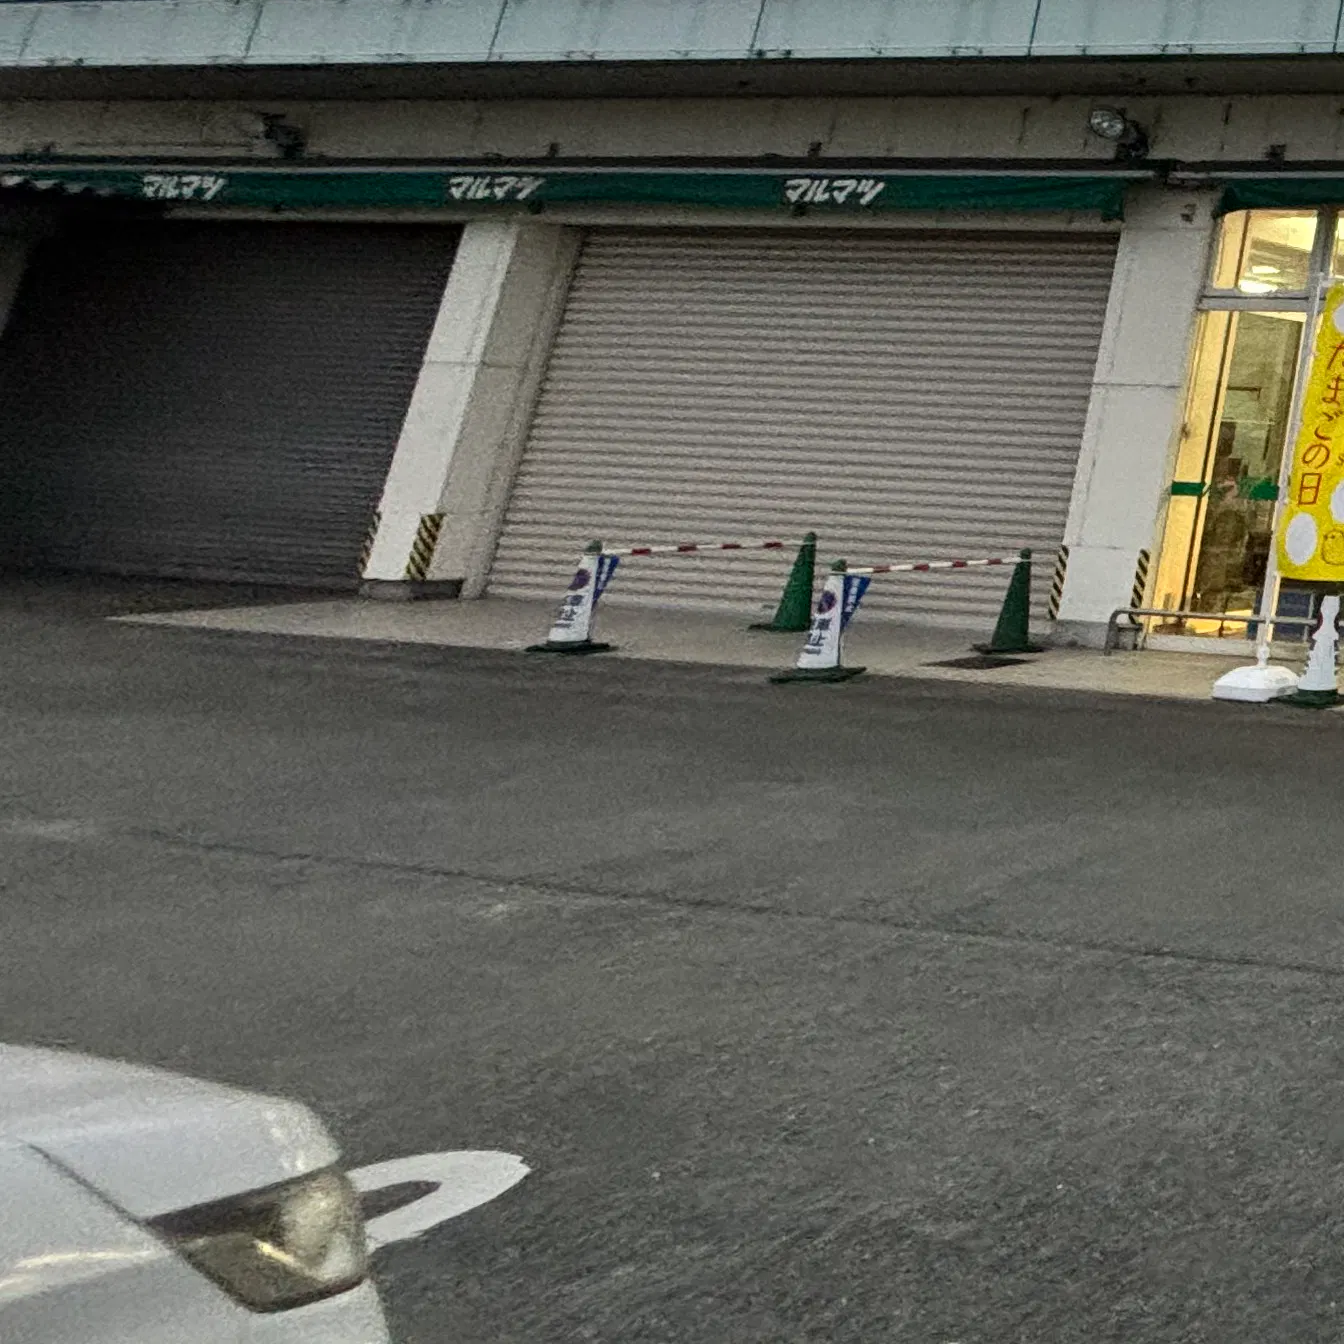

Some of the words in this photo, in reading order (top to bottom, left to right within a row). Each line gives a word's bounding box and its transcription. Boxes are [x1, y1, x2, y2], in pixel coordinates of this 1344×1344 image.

[144, 175, 226, 199] マルマツ
[449, 176, 542, 201] マルマツ
[784, 177, 885, 205] マルマツ
